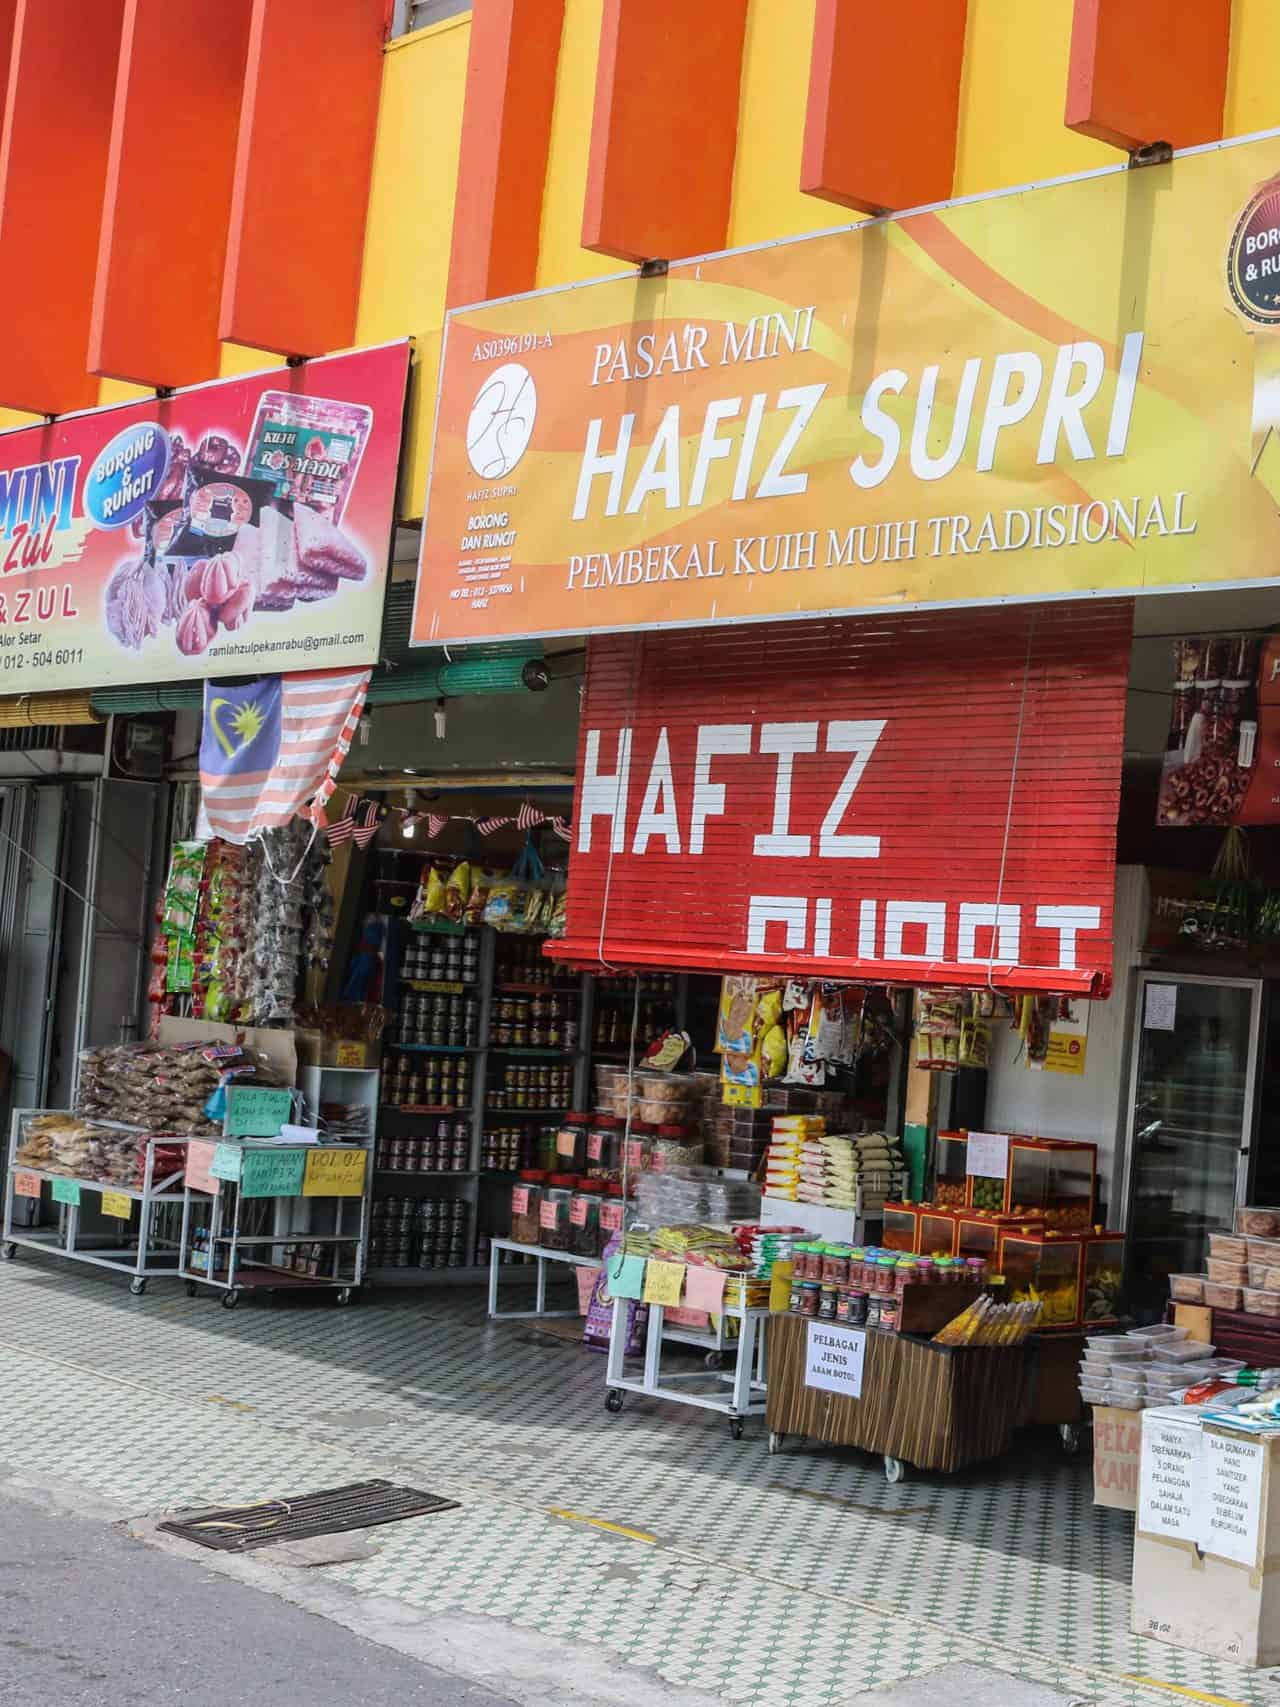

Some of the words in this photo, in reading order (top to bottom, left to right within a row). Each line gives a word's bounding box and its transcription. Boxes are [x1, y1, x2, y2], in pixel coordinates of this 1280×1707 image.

[1245, 263, 1258, 282] &
[472, 329, 553, 361] AS0396191-A
[591, 325, 709, 387] PASAR
[719, 306, 817, 366] MINI
[571, 383, 828, 522] HAFIZ
[849, 331, 1145, 490] SUPRI
[96, 430, 155, 484] BORONG
[123, 466, 132, 487] &
[103, 468, 155, 520] RUNCIT
[467, 511, 510, 531] BORONG
[3, 513, 57, 574] Zul
[460, 536, 481, 552] DAN
[484, 531, 516, 548] RUNCIT
[565, 540, 725, 590] PEMBEKAL
[733, 531, 818, 576] KUIH
[825, 520, 919, 569] MUIH
[926, 491, 1198, 558] TRADISIONAL
[18, 631, 42, 646] Setar
[4, 654, 24, 670] 012
[32, 651, 52, 668] 504
[55, 648, 83, 665] 6011
[578, 718, 887, 857] HAFIZ
[813, 1334, 857, 1351] PELBAGAI
[821, 1353, 847, 1366] JENIS
[1151, 1444, 1192, 1461] DIBENARKAN
[1226, 1443, 1257, 1458] GUNAKAN
[1162, 1462, 1185, 1475] ORANG
[1151, 1472, 1191, 1489] PELANGGAN
[1150, 1500, 1173, 1514] DALAM
